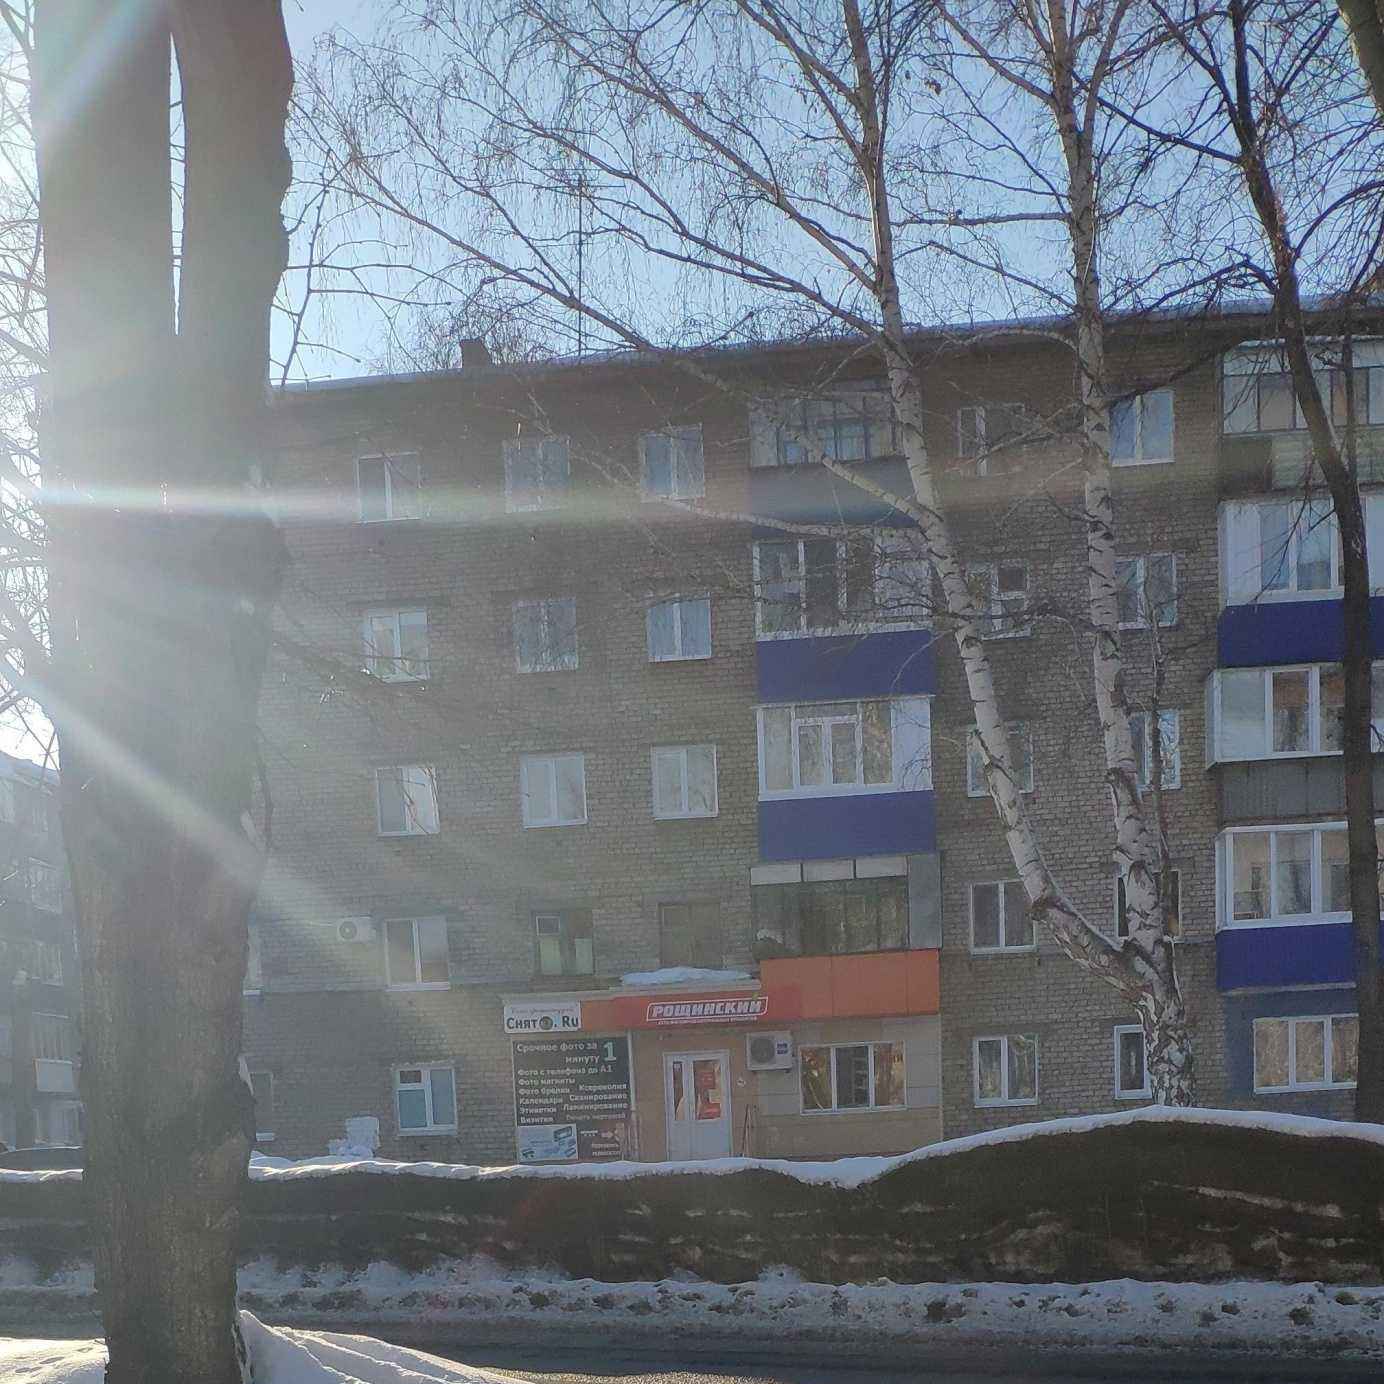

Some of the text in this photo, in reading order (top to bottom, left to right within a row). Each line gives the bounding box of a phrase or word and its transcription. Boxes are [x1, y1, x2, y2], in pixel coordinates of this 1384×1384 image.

[517, 1043, 558, 1053] Срочное
[586, 1042, 598, 1050] за
[603, 1041, 616, 1061] 1
[566, 1055, 600, 1065] минуту
